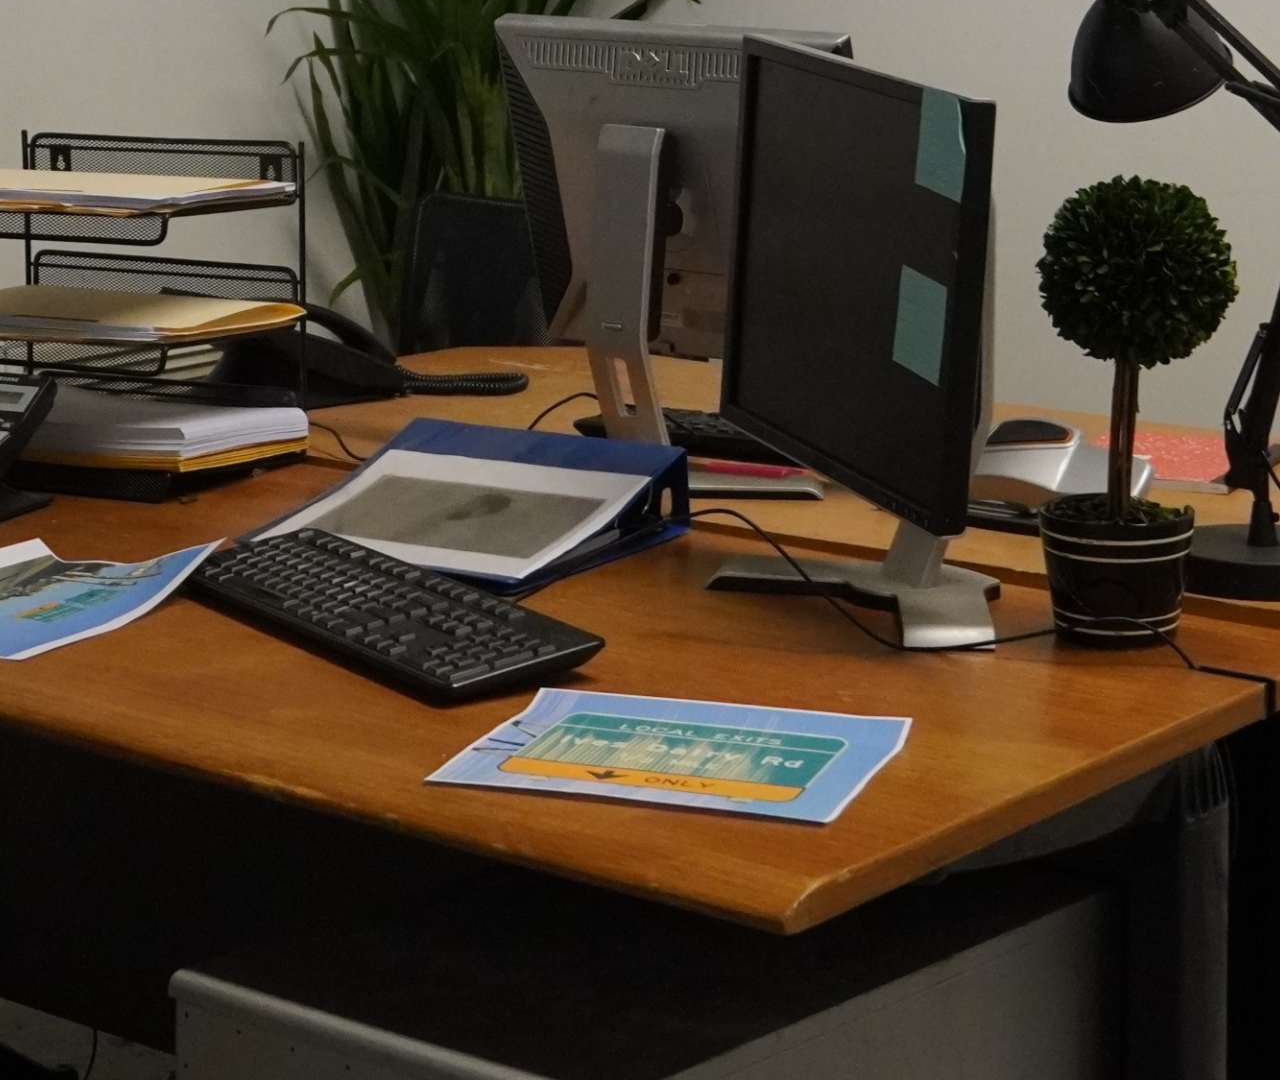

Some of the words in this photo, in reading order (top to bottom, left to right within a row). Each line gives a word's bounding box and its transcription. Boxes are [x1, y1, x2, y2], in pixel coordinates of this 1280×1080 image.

[619, 723, 697, 737] LOCAL
[713, 733, 784, 746] EXITS
[760, 755, 805, 769] Rd
[644, 775, 718, 789] ONLY
